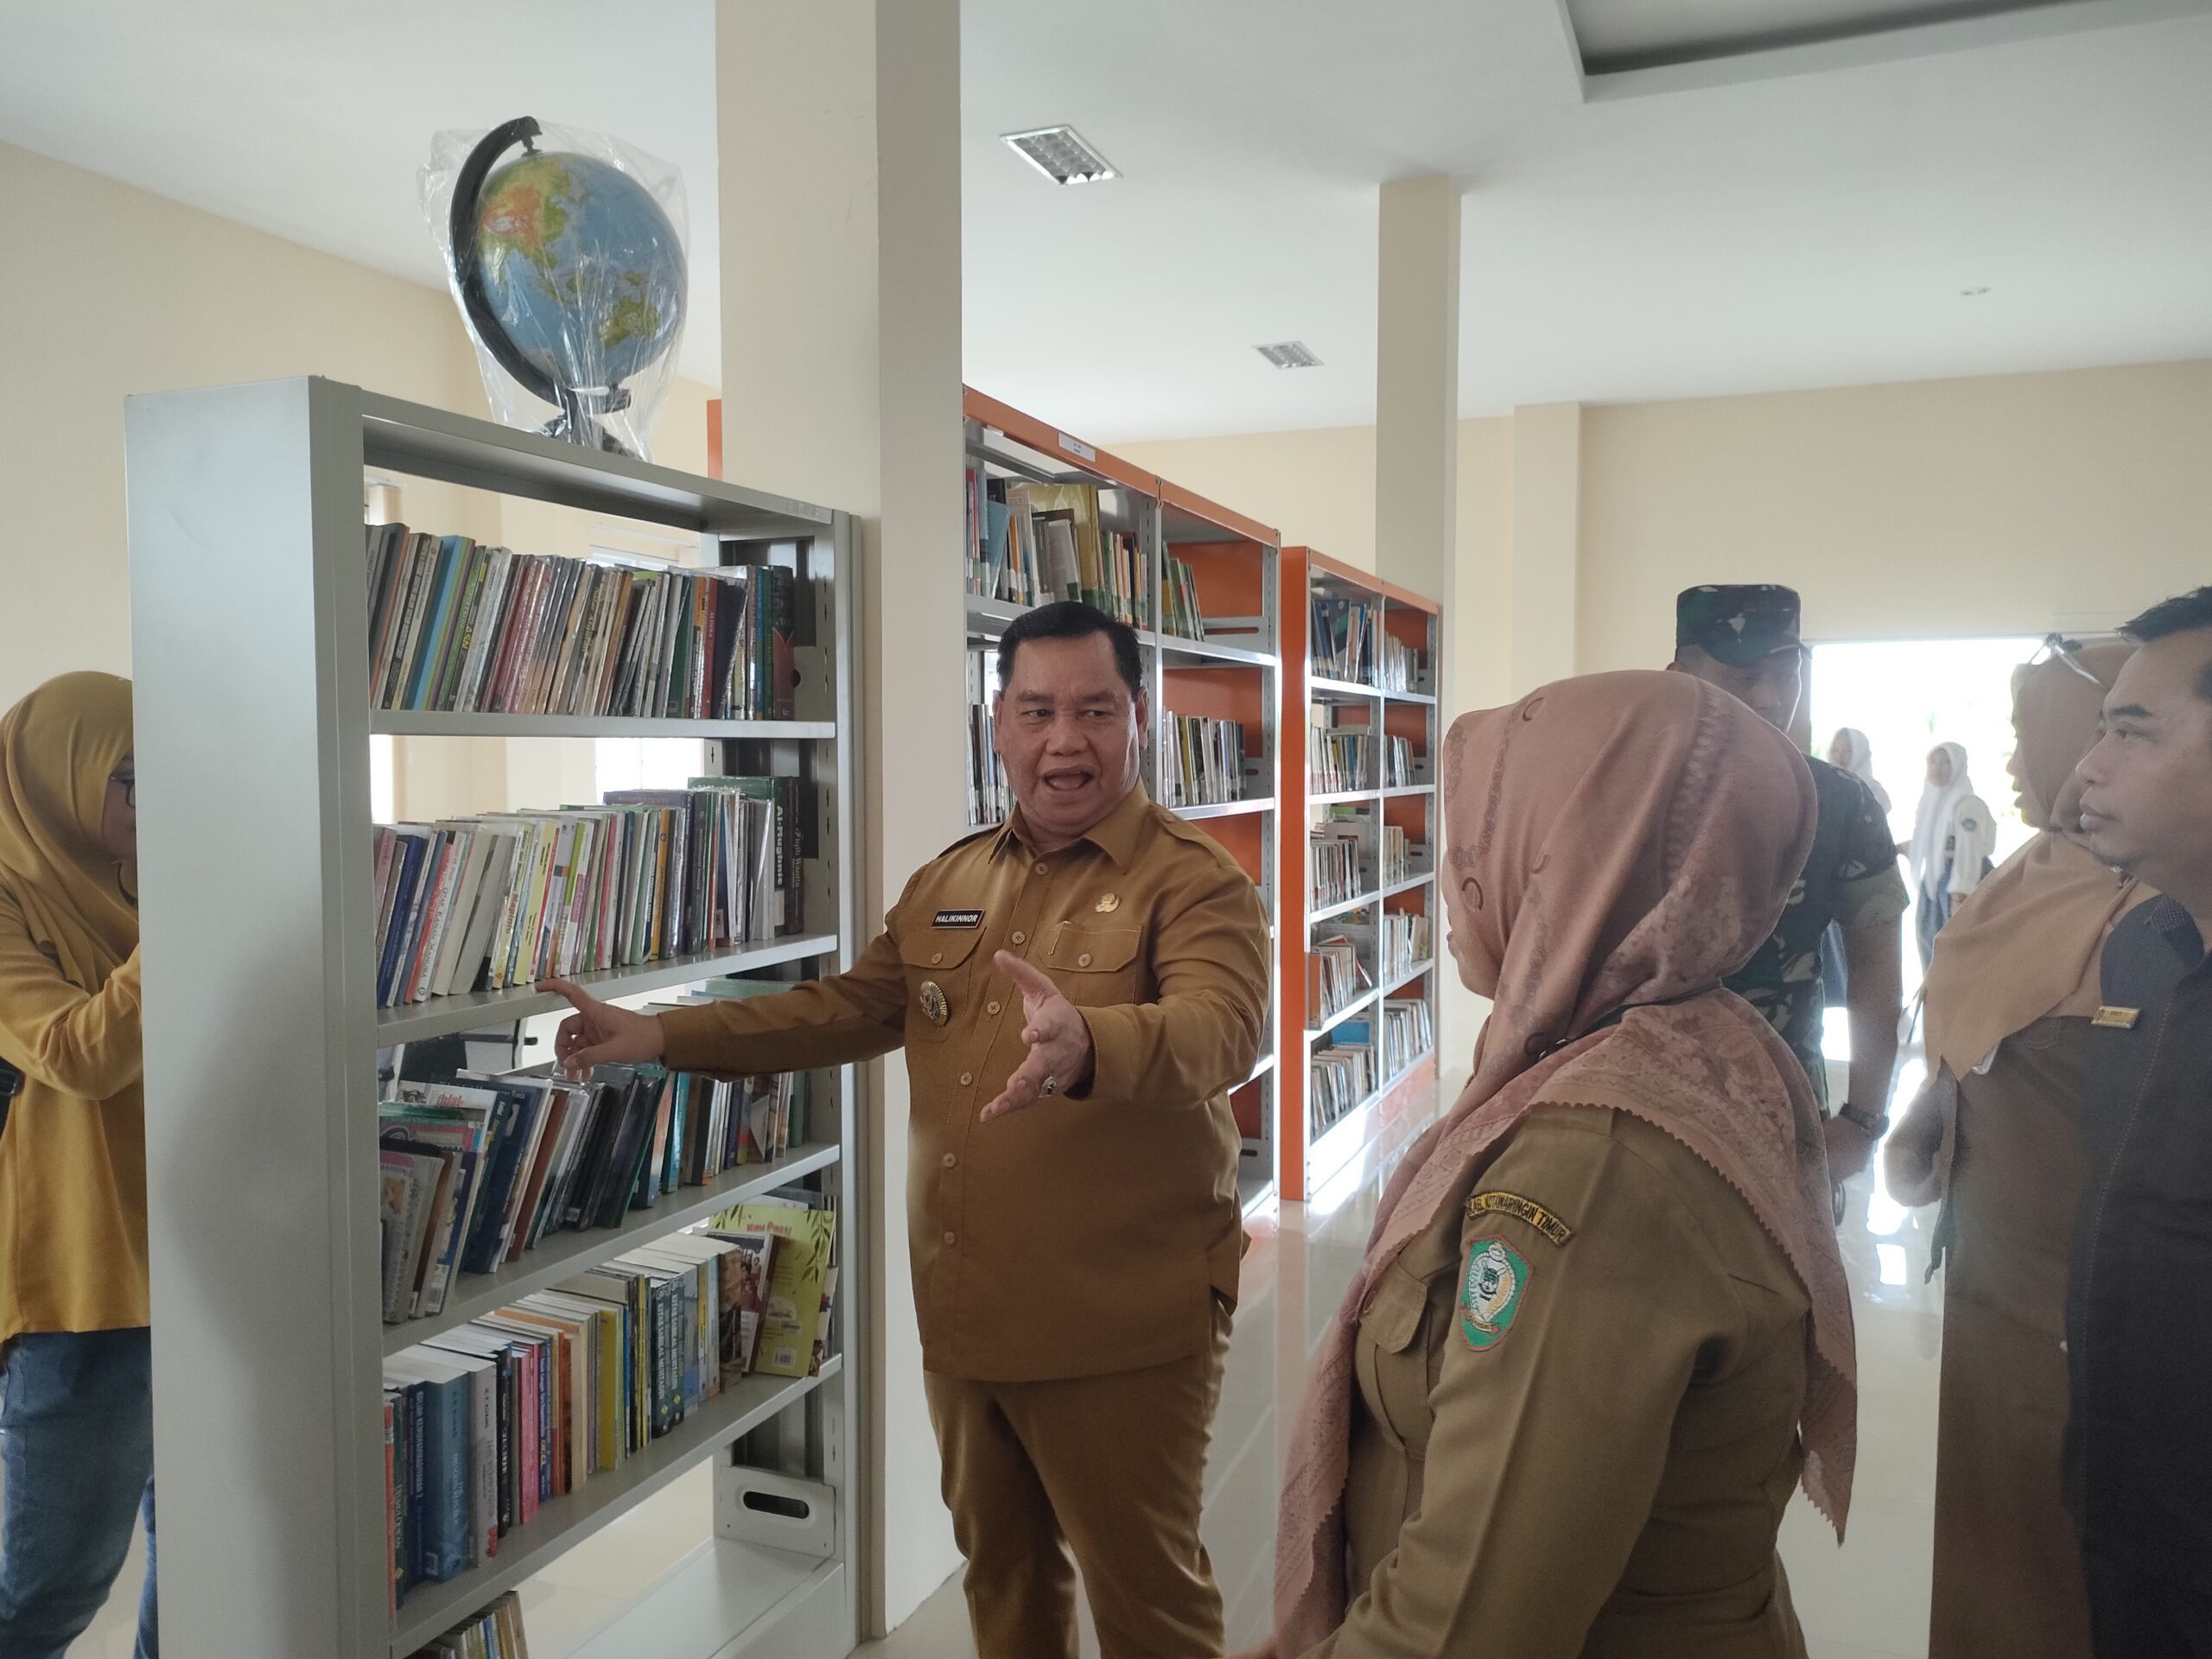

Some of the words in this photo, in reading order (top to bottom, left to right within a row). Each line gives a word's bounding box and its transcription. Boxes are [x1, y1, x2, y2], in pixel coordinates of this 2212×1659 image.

[438, 887, 448, 906] OTAK
[431, 911, 443, 941] KANAN
[935, 914, 978, 923] HALIKINNOR
